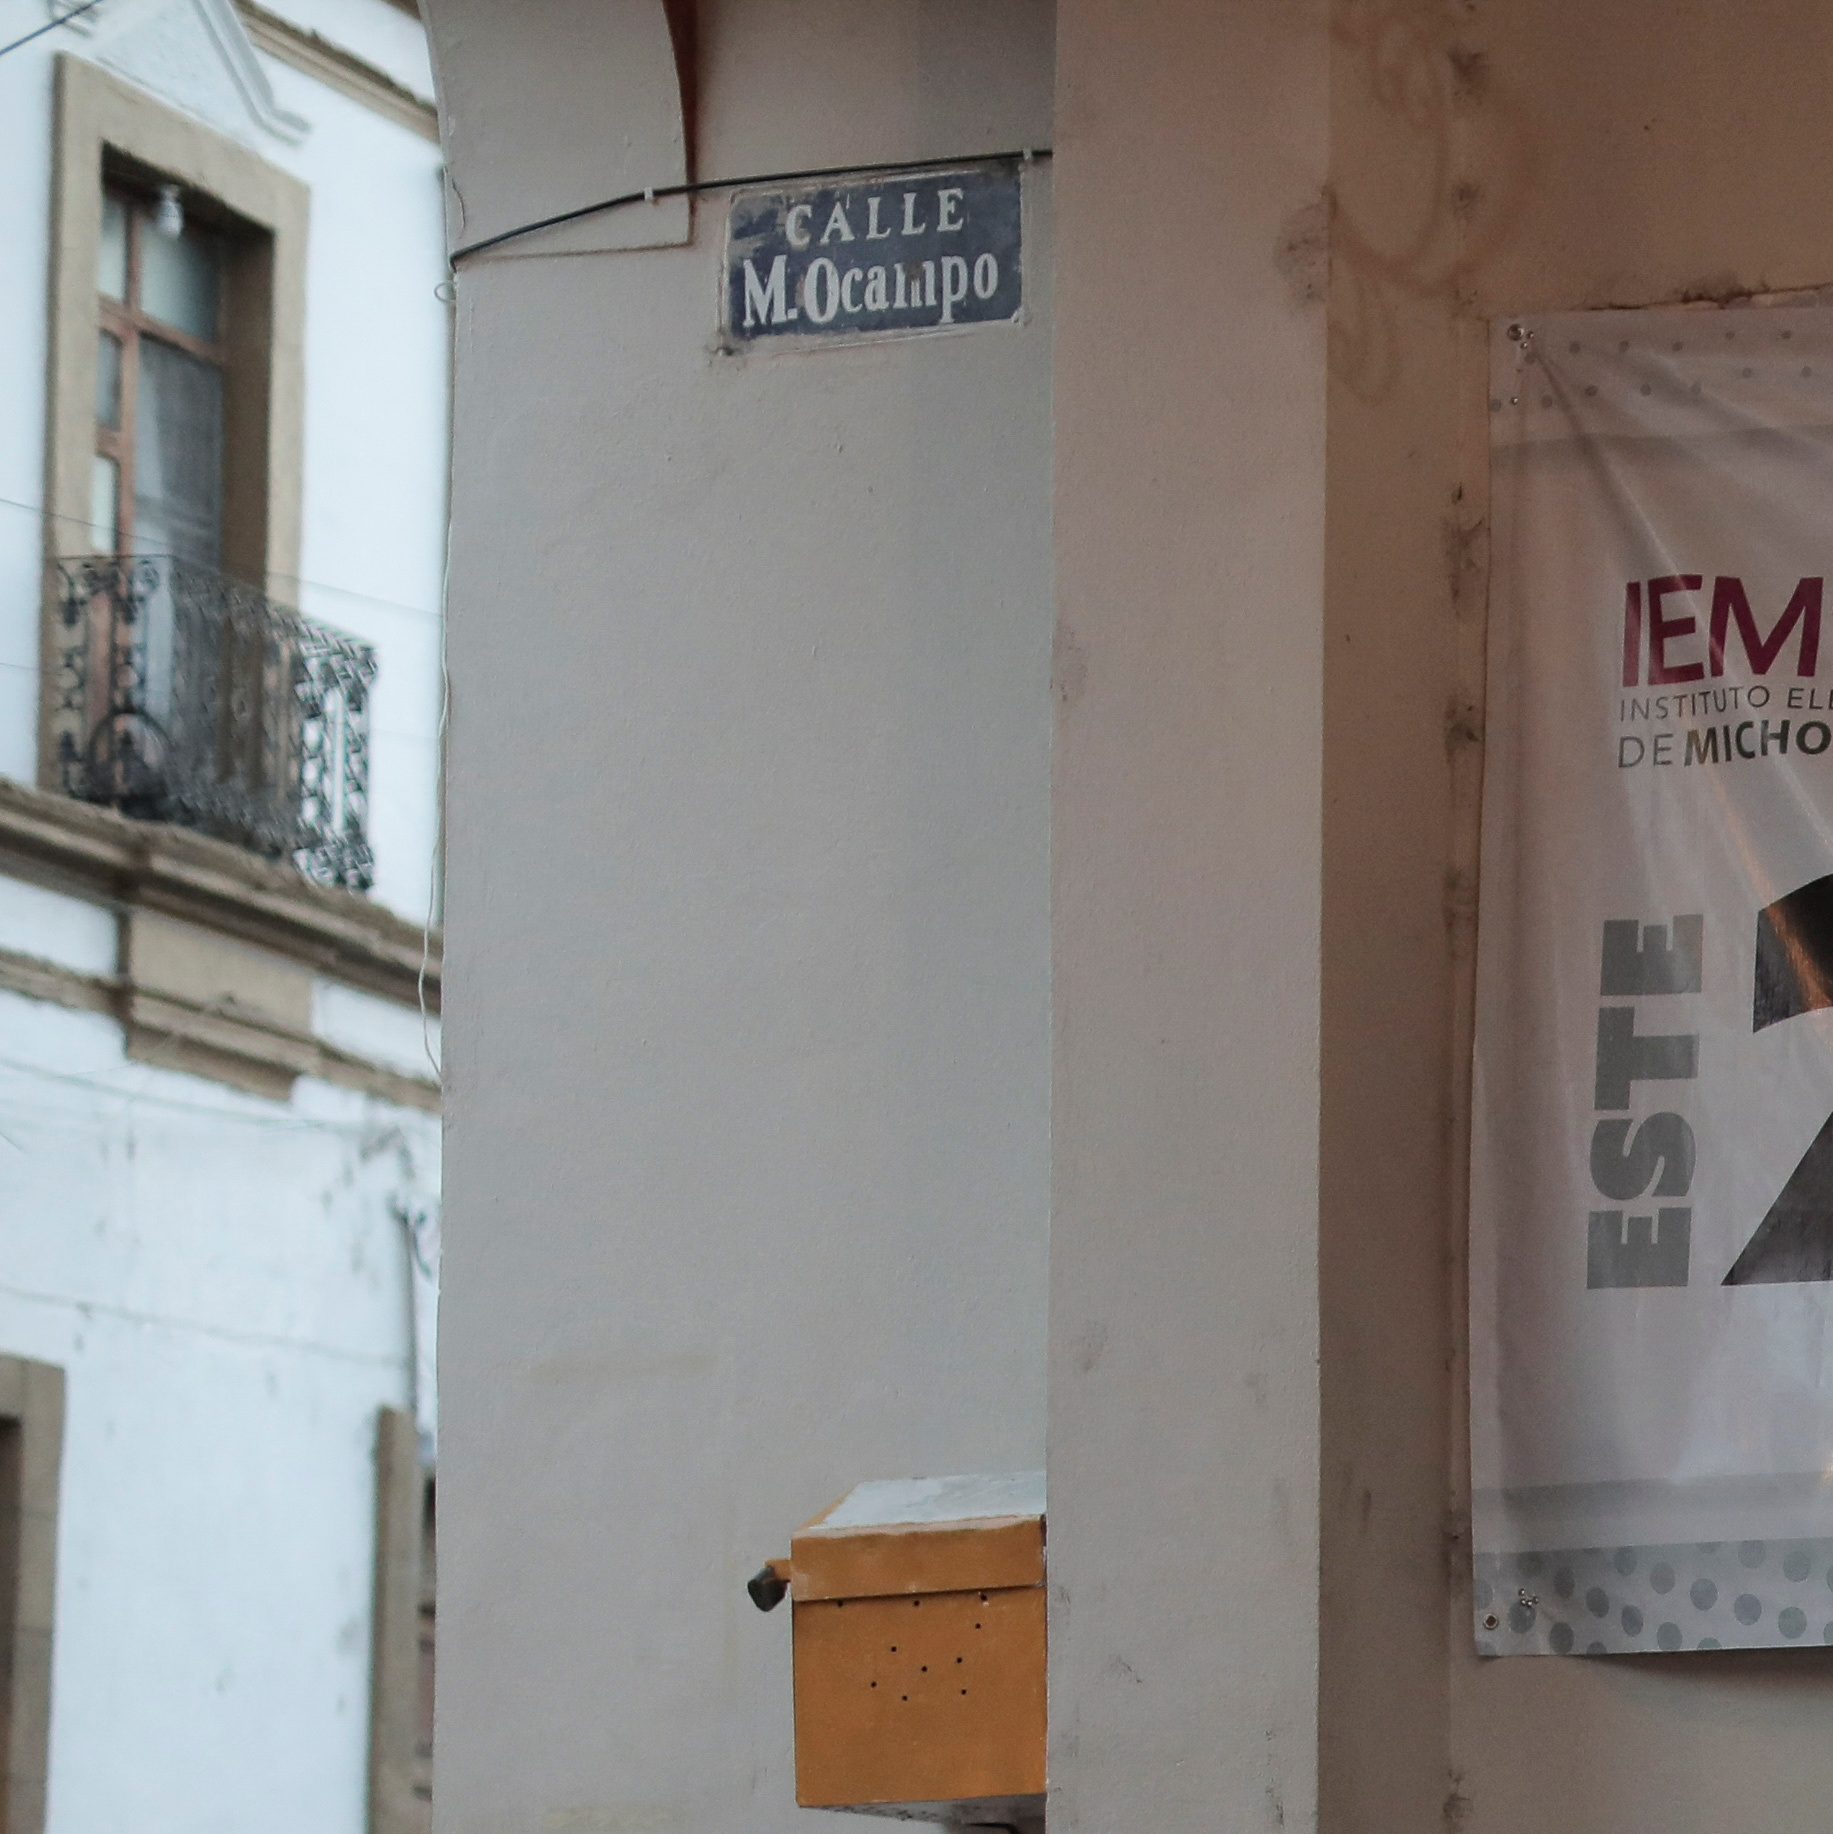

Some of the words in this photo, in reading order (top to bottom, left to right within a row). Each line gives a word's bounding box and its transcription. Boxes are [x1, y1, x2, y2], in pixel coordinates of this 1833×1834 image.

[785, 188, 965, 247] CALLE
[1622, 573, 1823, 687] IEM
[1619, 685, 1771, 723] INSTITUTO
[1617, 733, 1674, 768] DE
[1586, 913, 1704, 1290] ESTE
